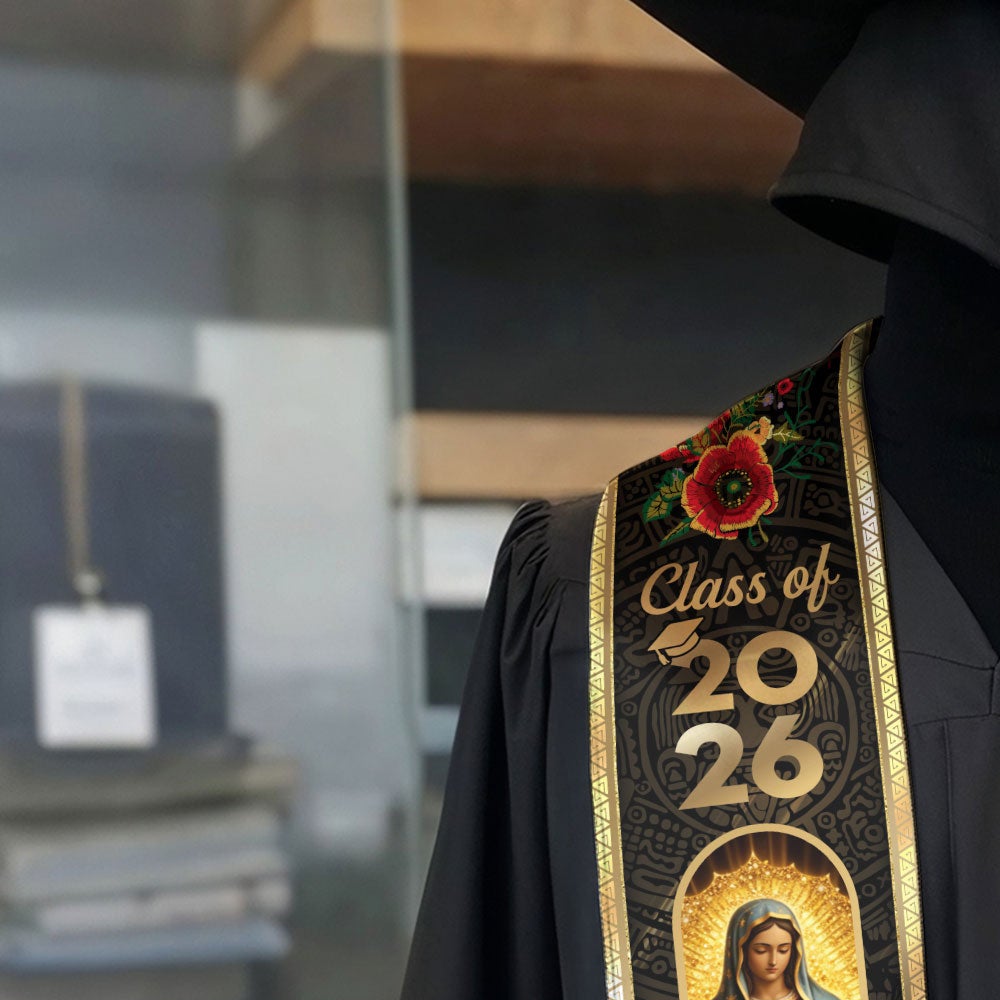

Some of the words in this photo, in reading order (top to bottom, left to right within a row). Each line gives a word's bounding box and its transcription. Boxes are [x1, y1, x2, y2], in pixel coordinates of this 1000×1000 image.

[640, 560, 767, 615] Class
[783, 543, 840, 613] of
[669, 630, 819, 716] 20
[675, 713, 824, 811] 26
